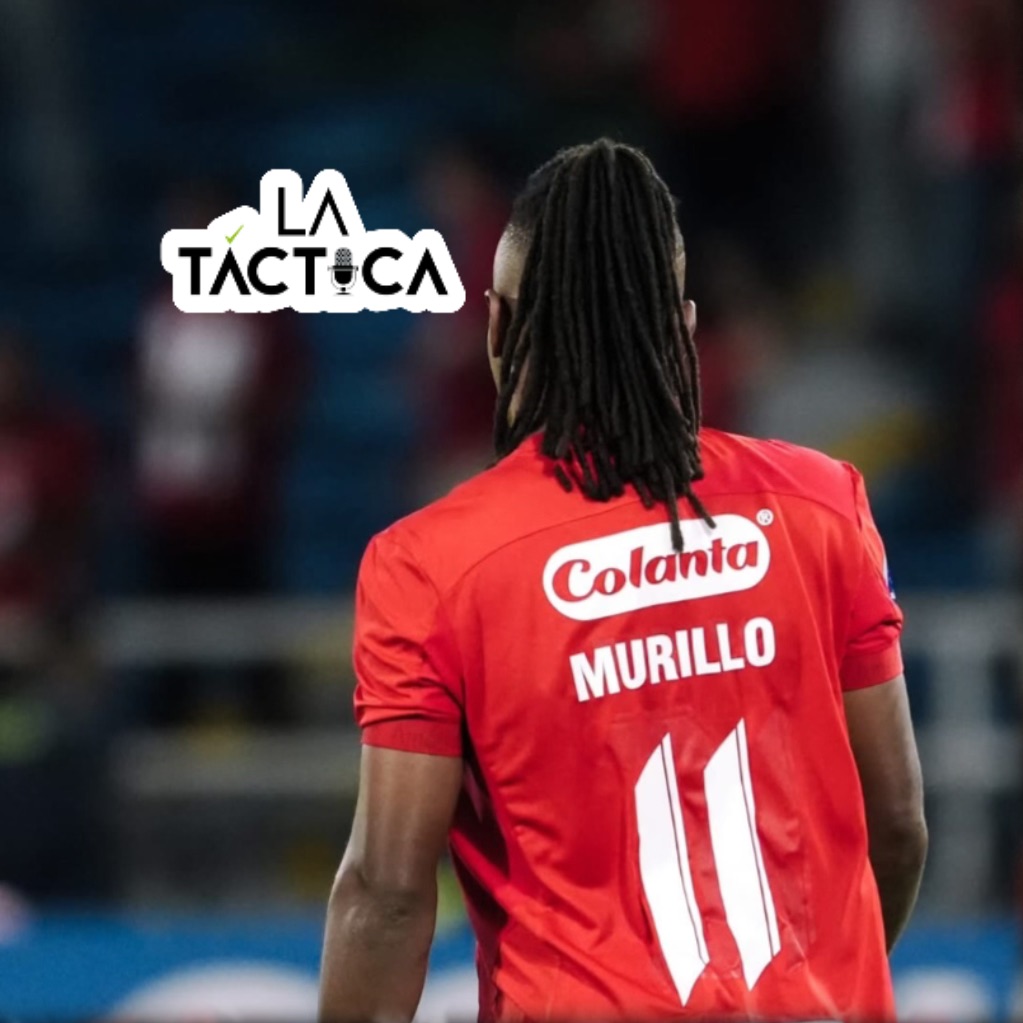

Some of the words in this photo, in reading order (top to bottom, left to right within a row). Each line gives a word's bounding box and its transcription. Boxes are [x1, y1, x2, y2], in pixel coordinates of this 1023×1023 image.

[551, 540, 759, 602] Colanta
[569, 617, 776, 702] MURILLO
[634, 718, 781, 1006] 11
